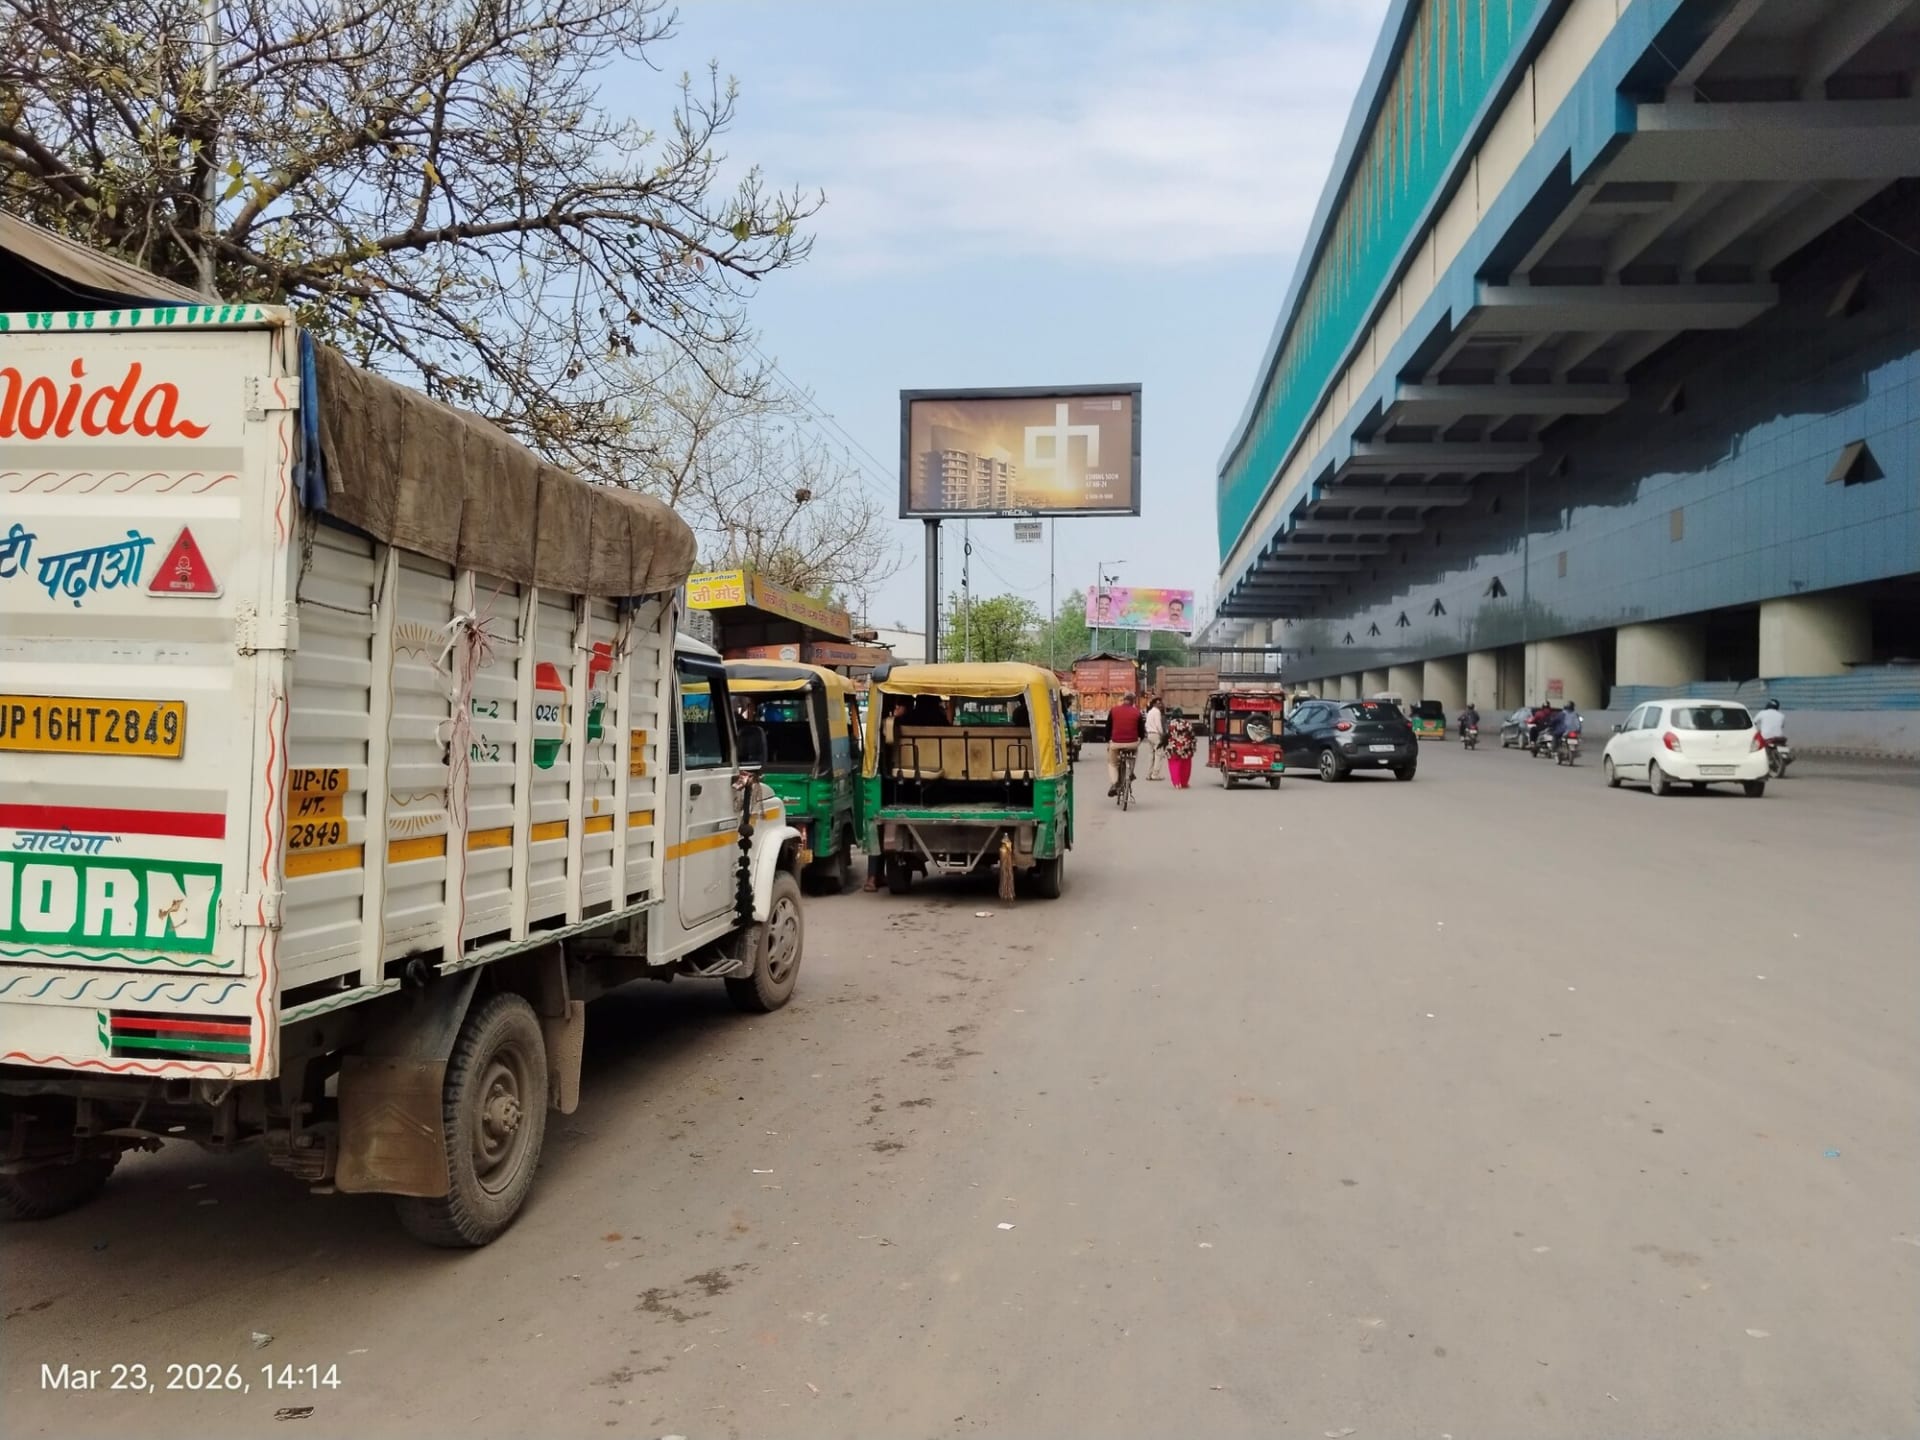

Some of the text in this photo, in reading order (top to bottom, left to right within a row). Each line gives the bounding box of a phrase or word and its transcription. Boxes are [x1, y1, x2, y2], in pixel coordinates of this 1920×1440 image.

[38, 530, 155, 608] पढ़ाओ
[289, 822, 340, 849] 2849
[0, 860, 217, 940] ORN
